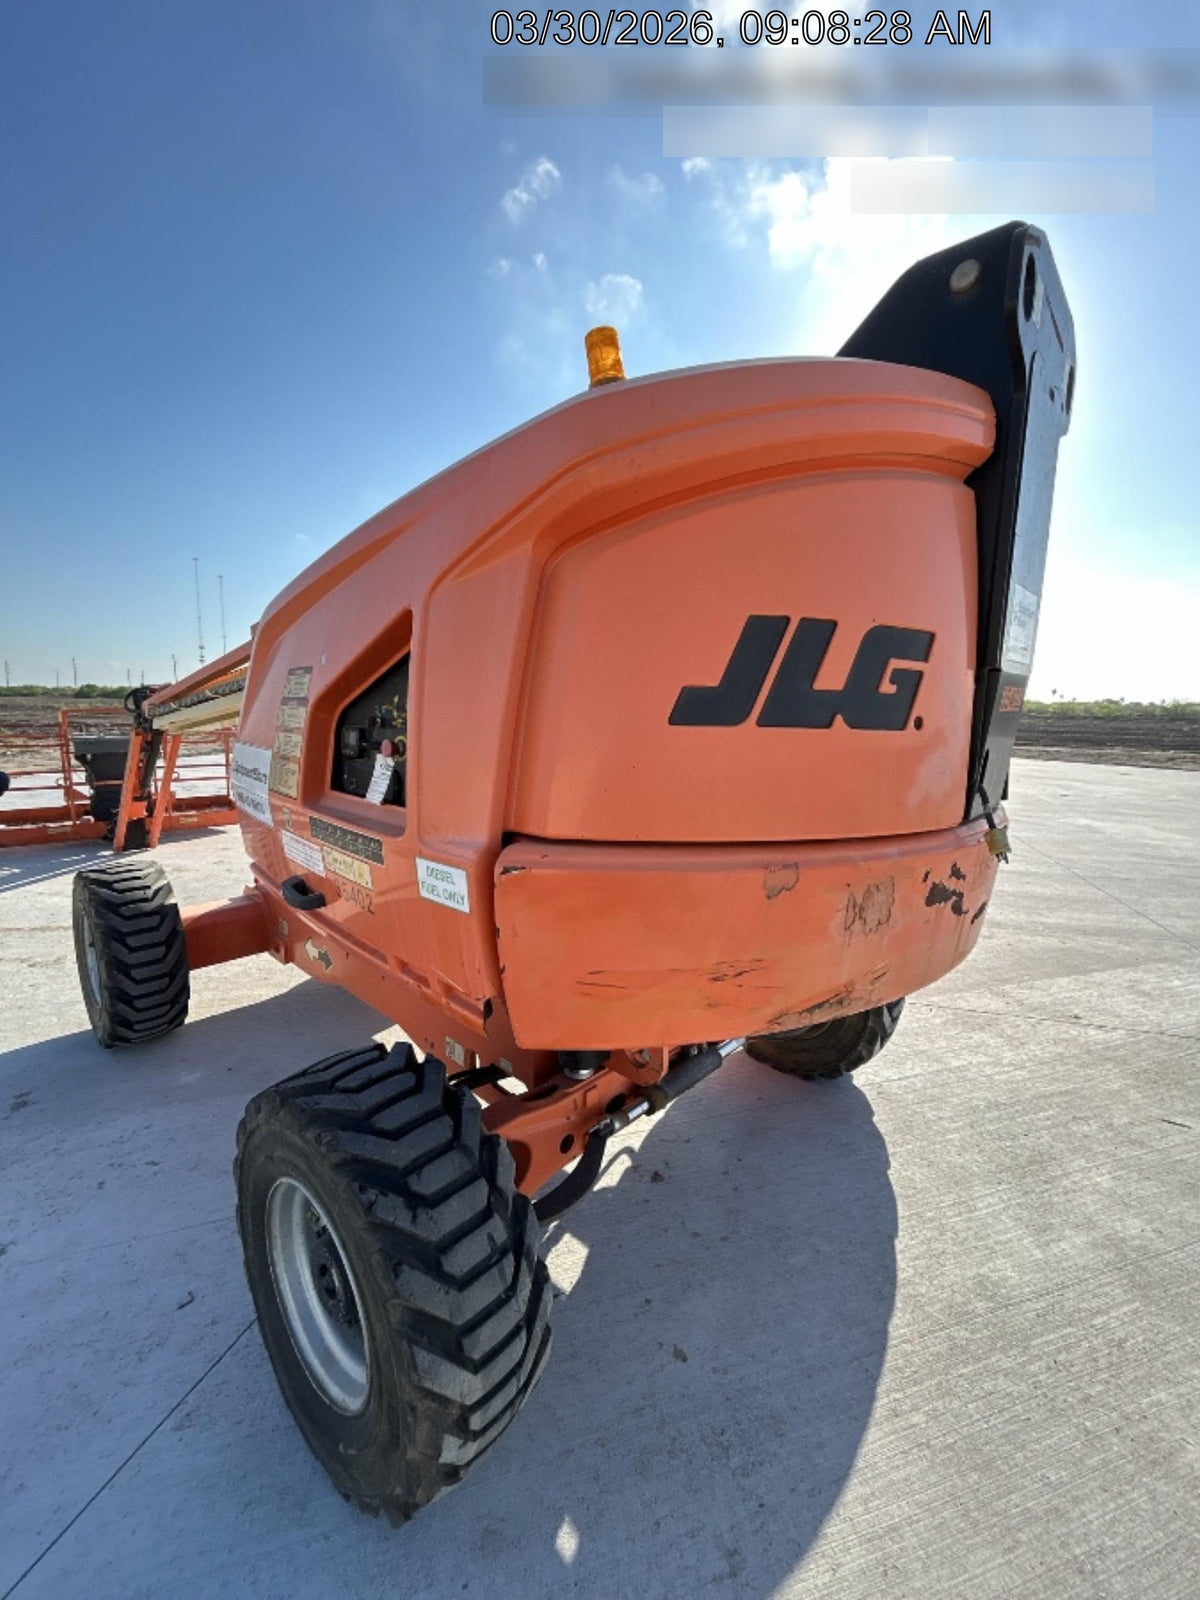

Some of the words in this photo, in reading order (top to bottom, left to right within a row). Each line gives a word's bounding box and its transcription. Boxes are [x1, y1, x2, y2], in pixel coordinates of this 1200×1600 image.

[668, 614, 936, 731] JLG
[426, 865, 455, 886] DIESEL
[421, 881, 441, 898] FUEL
[442, 888, 465, 906] ONLY
